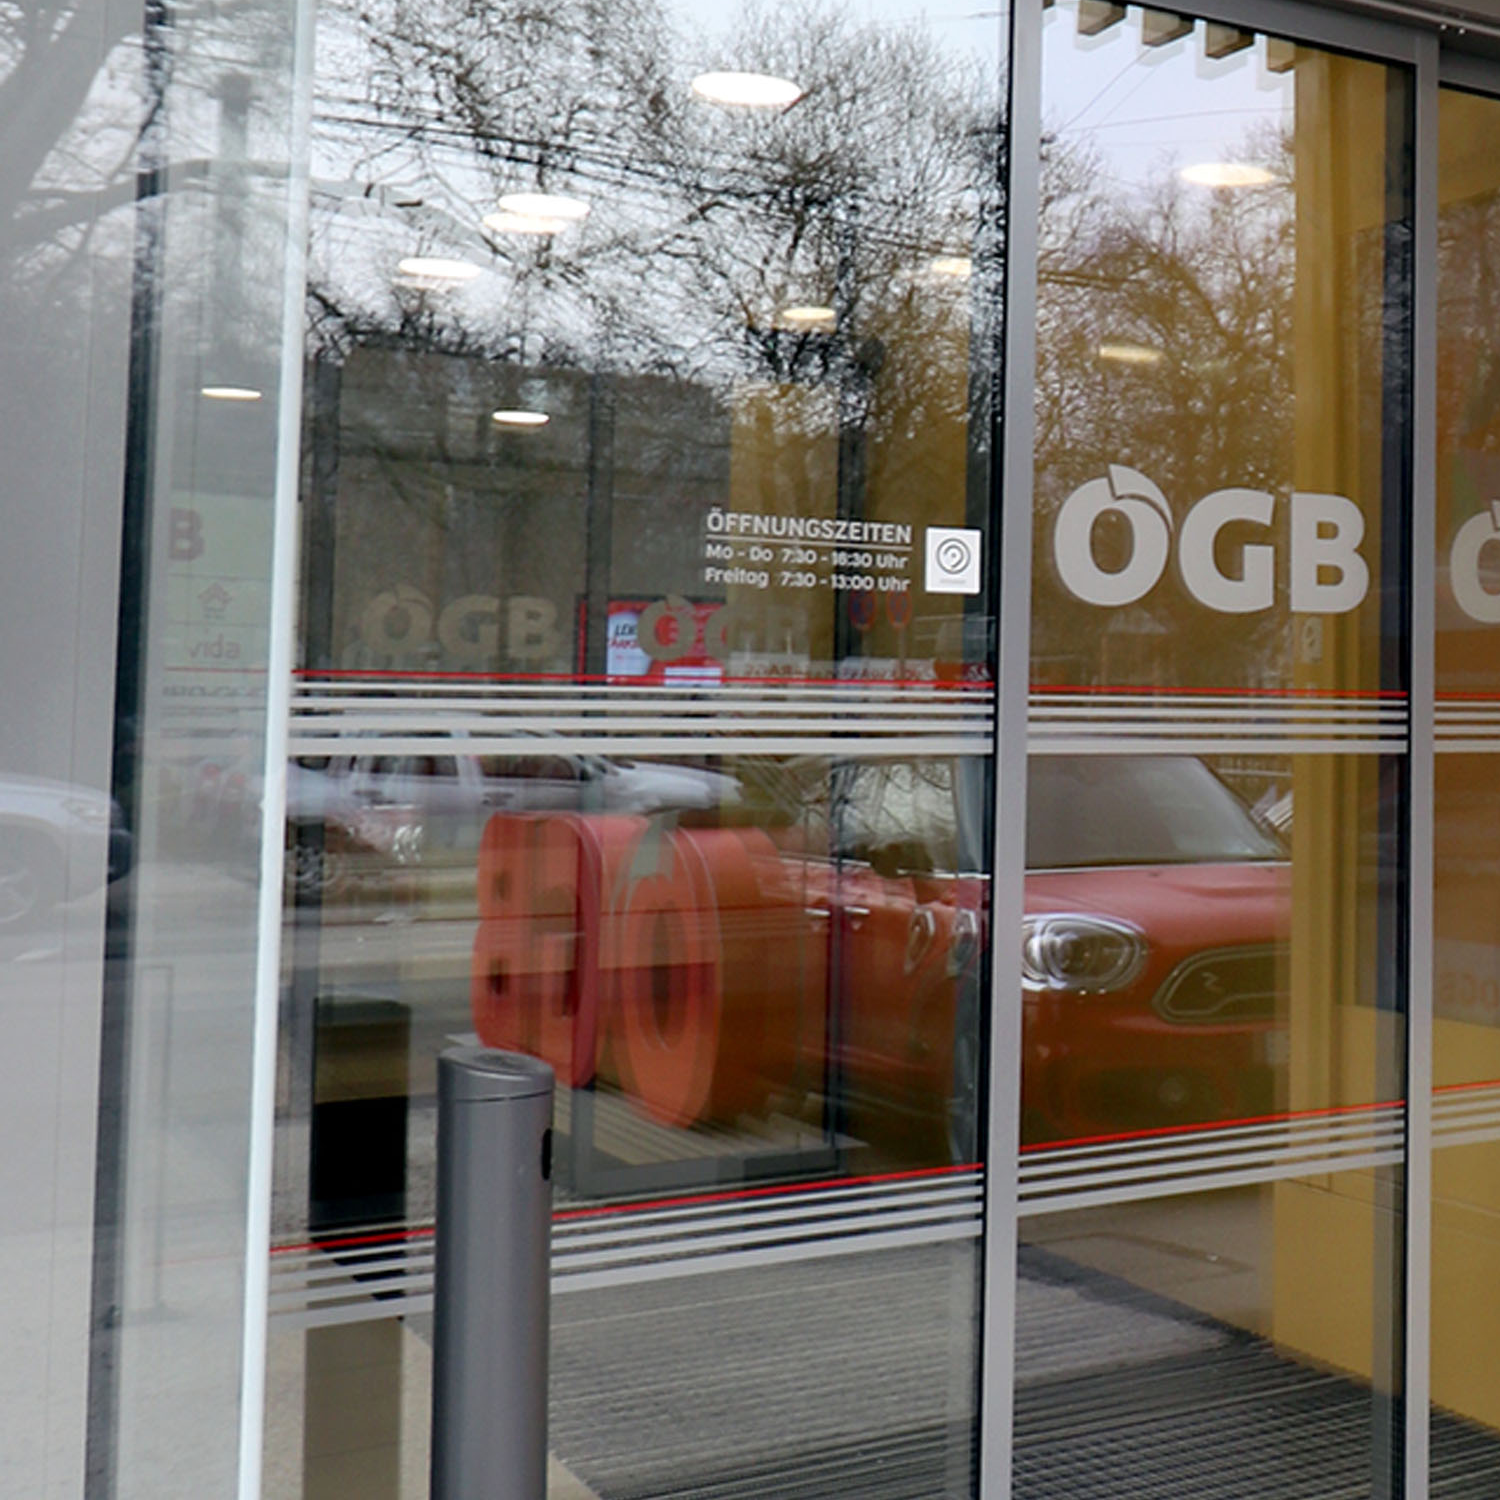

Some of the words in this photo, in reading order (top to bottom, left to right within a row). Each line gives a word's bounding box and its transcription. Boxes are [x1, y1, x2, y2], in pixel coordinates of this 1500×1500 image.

[706, 508, 912, 544] ÖFFNUNGSZEITEN
[705, 544, 733, 560] Mo
[750, 546, 774, 561] Do
[876, 552, 908, 568] Uhr
[705, 567, 769, 588] Freitag
[831, 575, 874, 589] 13:00
[878, 577, 911, 592] Uhr
